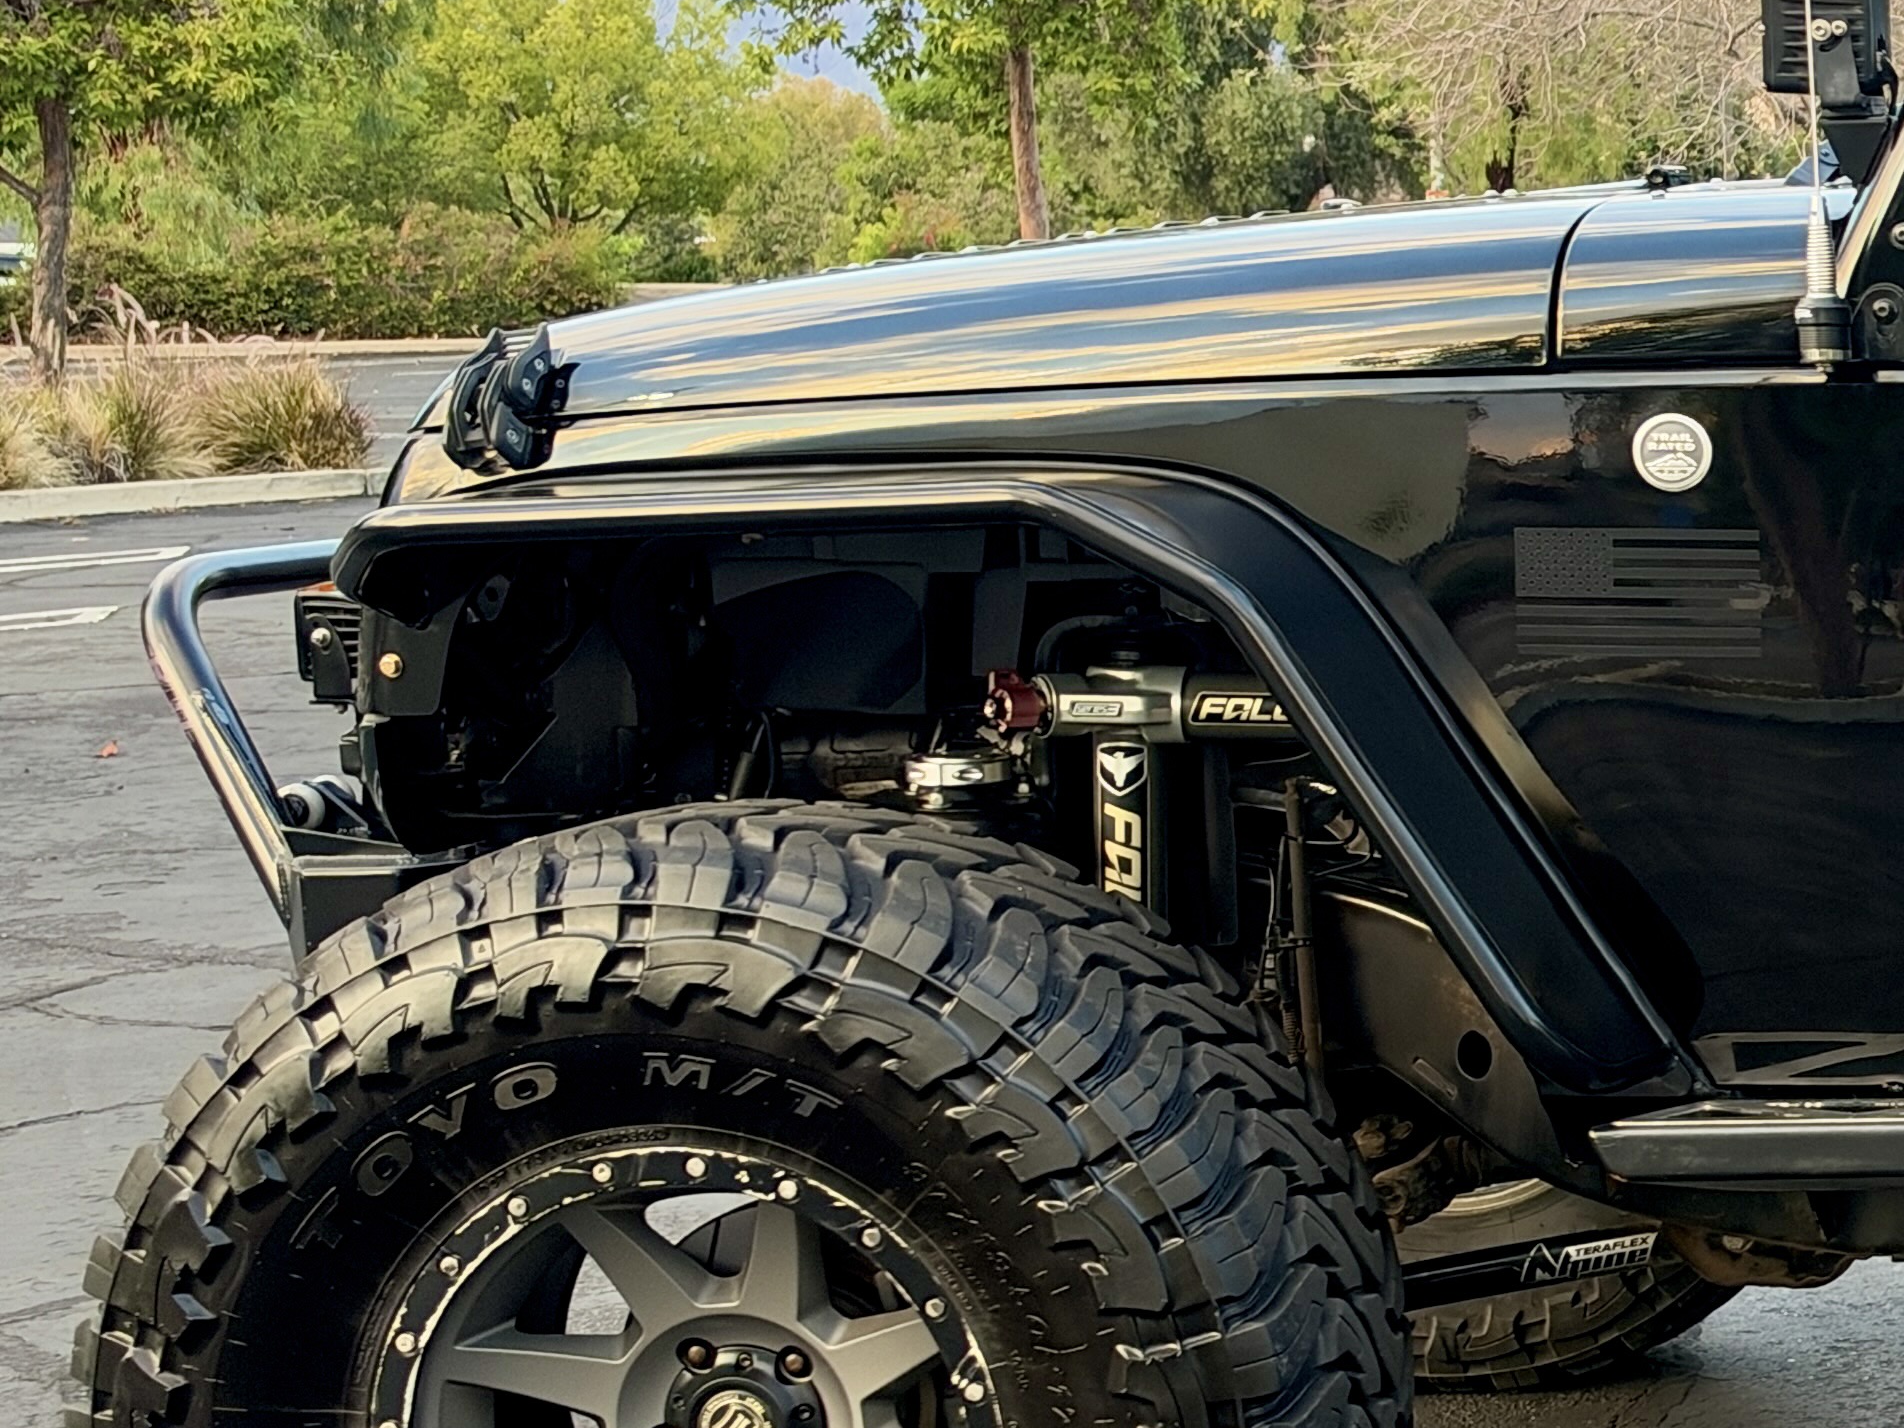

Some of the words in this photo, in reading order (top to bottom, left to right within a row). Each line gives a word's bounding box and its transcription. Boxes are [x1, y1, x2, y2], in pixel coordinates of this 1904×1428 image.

[1648, 433, 1694, 442] TRAIL
[1647, 442, 1697, 451] RATED
[290, 1061, 558, 1249] TOYO
[641, 1051, 844, 1118] M/T
[1574, 1234, 1650, 1258] TERAFLEX
